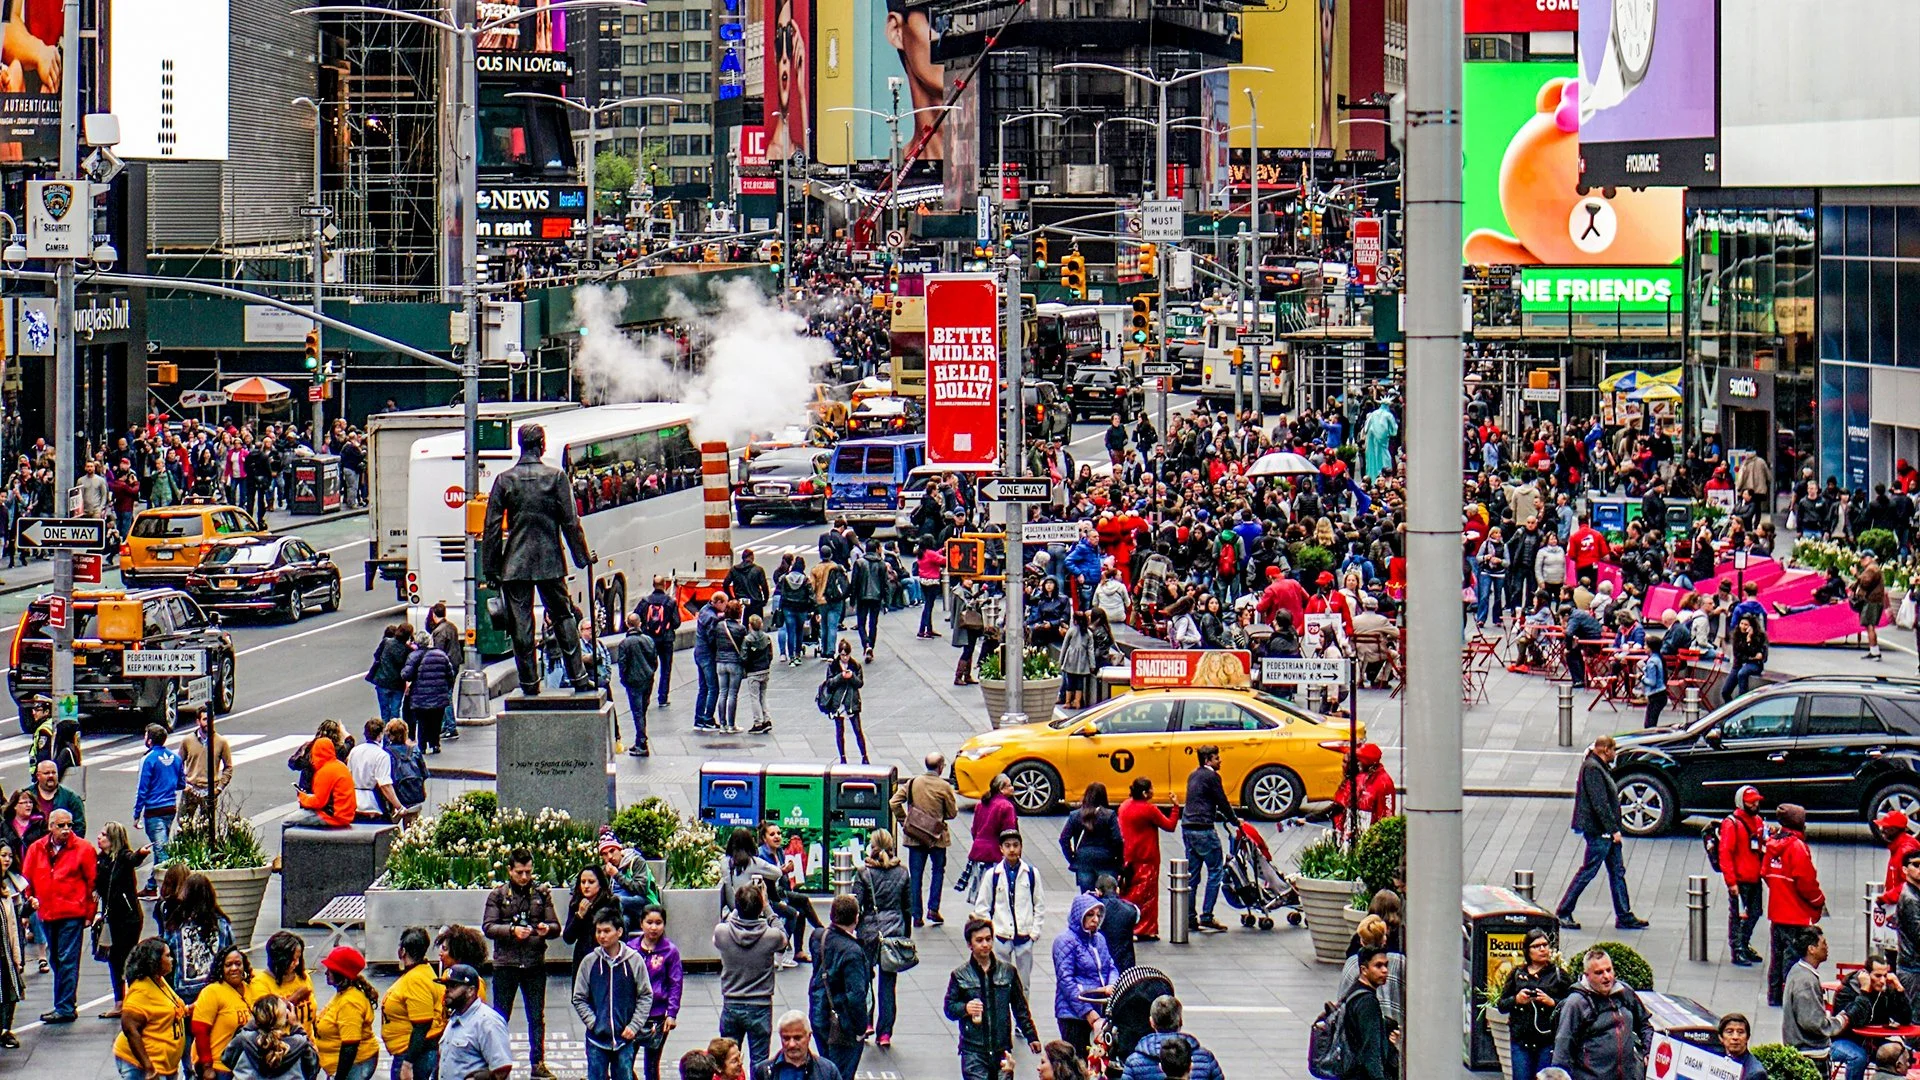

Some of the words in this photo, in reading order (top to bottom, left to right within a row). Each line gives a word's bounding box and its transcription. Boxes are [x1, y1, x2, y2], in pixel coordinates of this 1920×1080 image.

[506, 58, 522, 72] IN
[524, 58, 552, 72] LOVE
[4, 99, 62, 112] AUTHENTICALLY
[1626, 154, 1660, 172] #YOURMOVE
[490, 190, 550, 210] NEWS
[1152, 217, 1174, 225] MUST
[44, 224, 71, 232] SECURITY
[495, 220, 532, 236] rant
[1557, 278, 1671, 302] FRIENDS
[75, 299, 112, 340] unglass
[113, 298, 130, 330] hut
[1176, 317, 1184, 325] W
[1186, 316, 1194, 325] 45
[933, 328, 992, 344] BETTE
[929, 345, 996, 361] MIDLER
[934, 364, 993, 384] HELLO,
[934, 382, 992, 400] DOLLY!
[1000, 486, 1019, 494] ONE
[1023, 486, 1044, 494] WAY
[44, 528, 66, 540] ONE
[71, 528, 94, 540] WAY
[128, 654, 162, 662] PEDESTRIAN
[164, 654, 179, 662] FLOW
[181, 654, 196, 662] ZONE
[128, 664, 142, 672] KEEP
[144, 664, 166, 672] MOVING
[1136, 660, 1187, 676] SNATCHED
[1266, 662, 1303, 670] PEDESTRIAN
[1306, 662, 1321, 670] FLOW
[1323, 662, 1338, 670] ZONE
[1266, 672, 1280, 680] KEEP
[1284, 672, 1306, 680] MOVING
[784, 818, 809, 826] PAPER
[850, 818, 876, 826] TRASH
[1656, 1053, 1670, 1064] STOP
[1684, 1056, 1704, 1070] ORGAN
